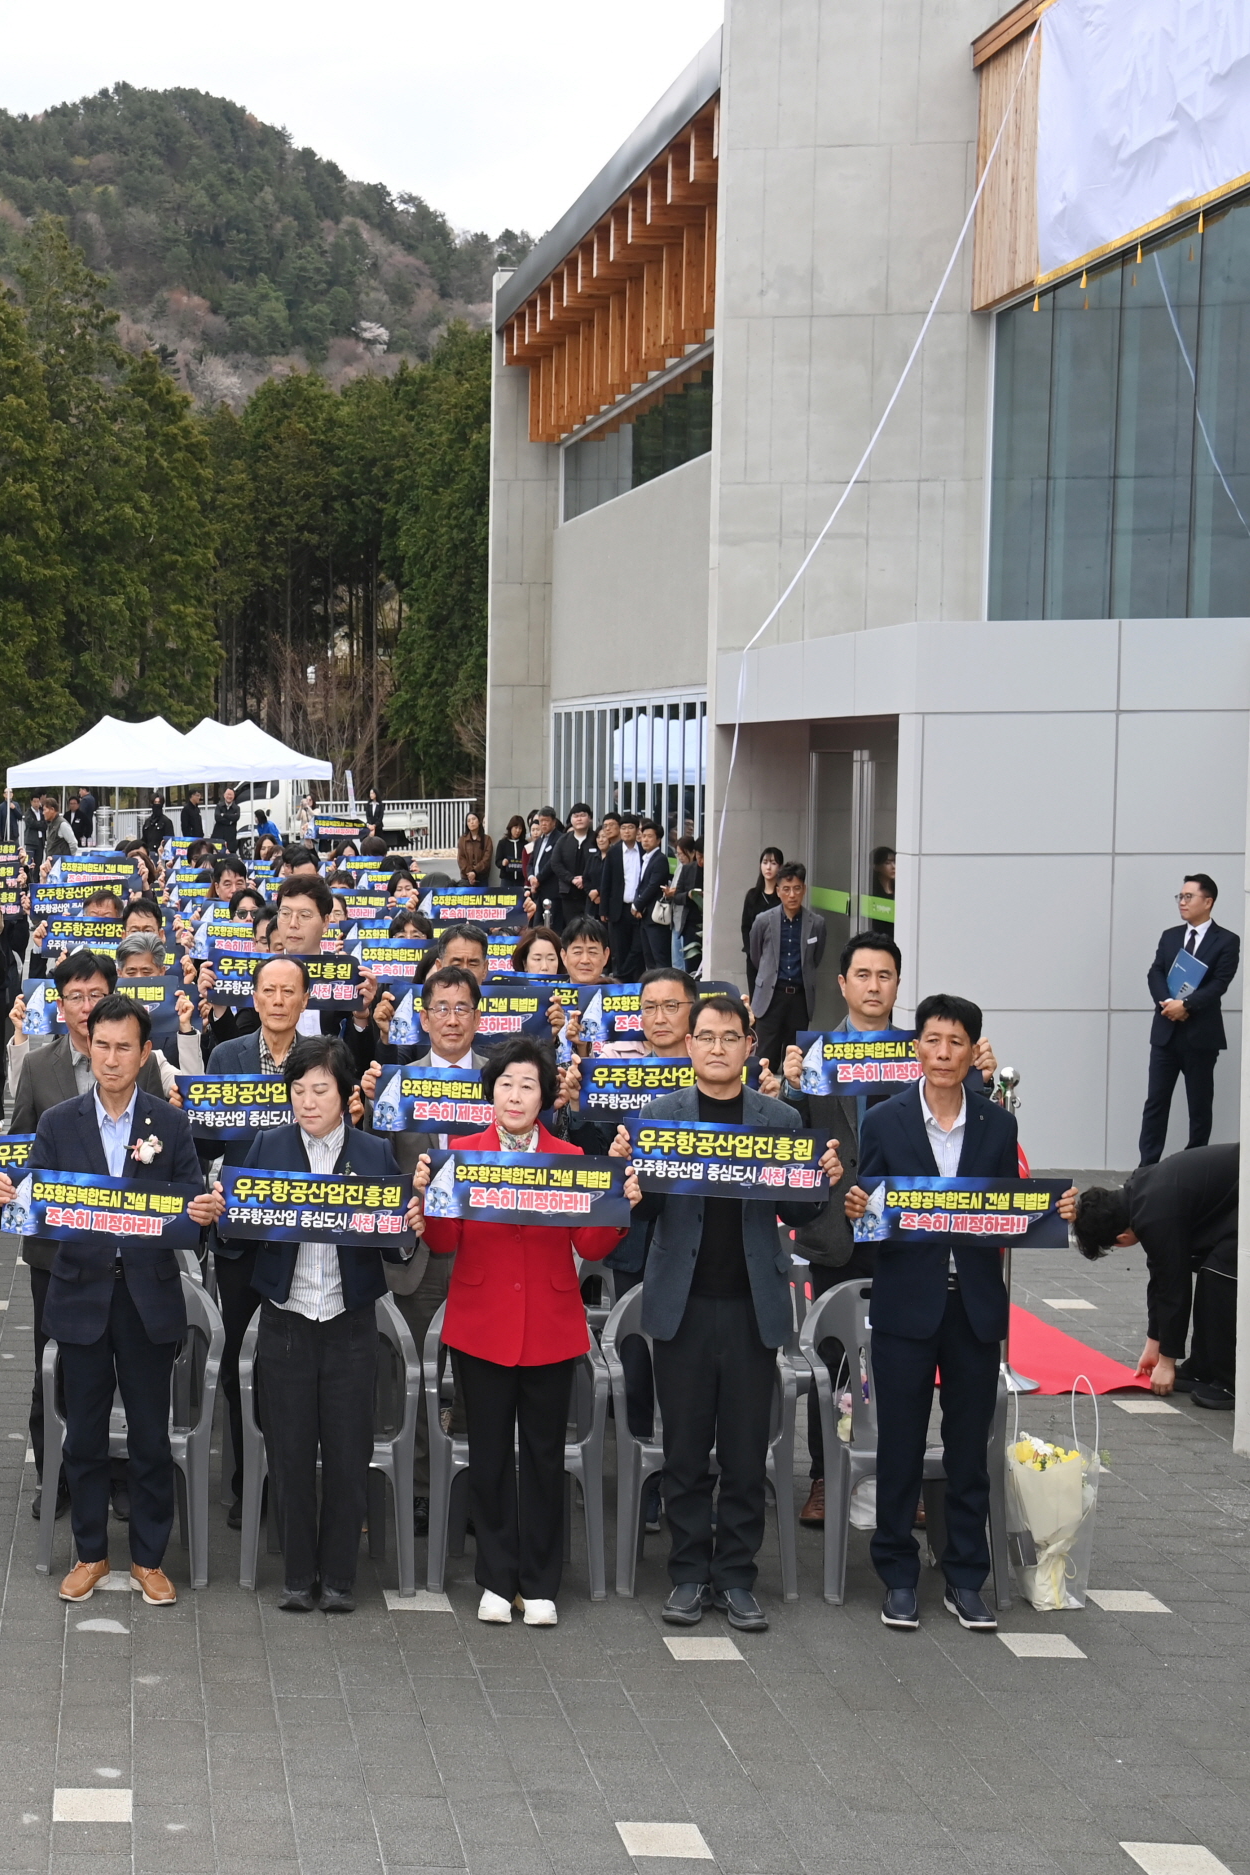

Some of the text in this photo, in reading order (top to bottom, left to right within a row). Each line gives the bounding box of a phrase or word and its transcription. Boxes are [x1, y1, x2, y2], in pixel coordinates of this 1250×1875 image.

[432, 895, 482, 905] 우주항공복합도시
[347, 907, 376, 918] 정하라!!
[440, 908, 507, 920] 조속히 제정하라!!
[207, 926, 254, 938] 우주항공복합도
[362, 949, 423, 961] 우주항공복합도시
[371, 964, 405, 976] 조속히
[311, 984, 332, 999] 사천
[333, 984, 358, 1000] 설립!
[488, 997, 538, 1012] 건설 특별법
[603, 996, 641, 1011] 우주항공
[478, 1015, 522, 1032] 정하라!!
[823, 1042, 906, 1060] 우주항공복합도시
[837, 1062, 923, 1082] 조속히 제정하
[188, 1082, 288, 1105] 우주항공산업
[401, 1079, 482, 1100] 우주항공복합도시
[187, 1110, 292, 1127] 우주항공산업 중심도시
[413, 1102, 496, 1123] 조속히 제정하
[637, 1129, 814, 1161] 우주항공산업진흥원
[455, 1165, 611, 1189] 우주항공복합도시 건설 특별법
[632, 1158, 822, 1188] 우주항공산업 중심도시 사천 설립!
[32, 1182, 184, 1214] 우주항공복합도시 건설 특별법
[233, 1177, 401, 1208] 우주항공산업진흥원
[469, 1187, 590, 1212] 조속히 제정하라!!
[885, 1191, 1050, 1211] 우주항공복합도시 건설 특별법
[45, 1206, 163, 1236] 조속히 제정하라!!
[227, 1207, 408, 1233] 우주항공산업 중심도시 사천 설립!
[900, 1212, 1028, 1234] 조속히 제정하라!!
